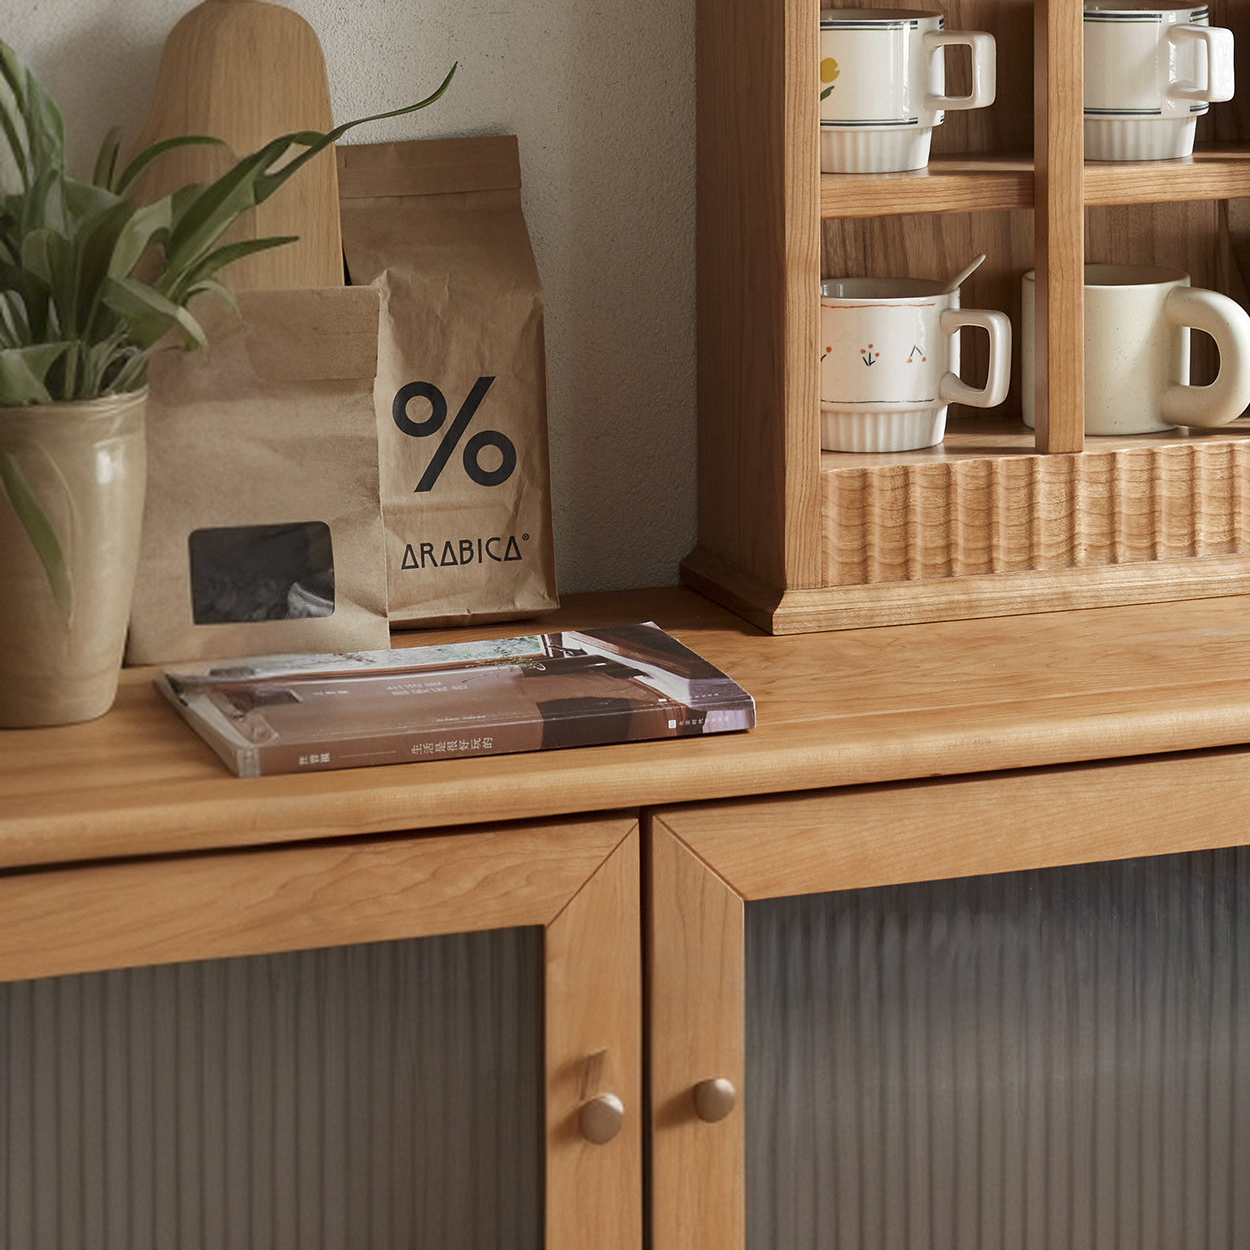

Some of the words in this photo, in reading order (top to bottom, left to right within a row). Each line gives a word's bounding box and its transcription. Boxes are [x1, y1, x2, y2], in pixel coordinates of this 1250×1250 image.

[410, 737, 494, 755] 生活是很好玩的
